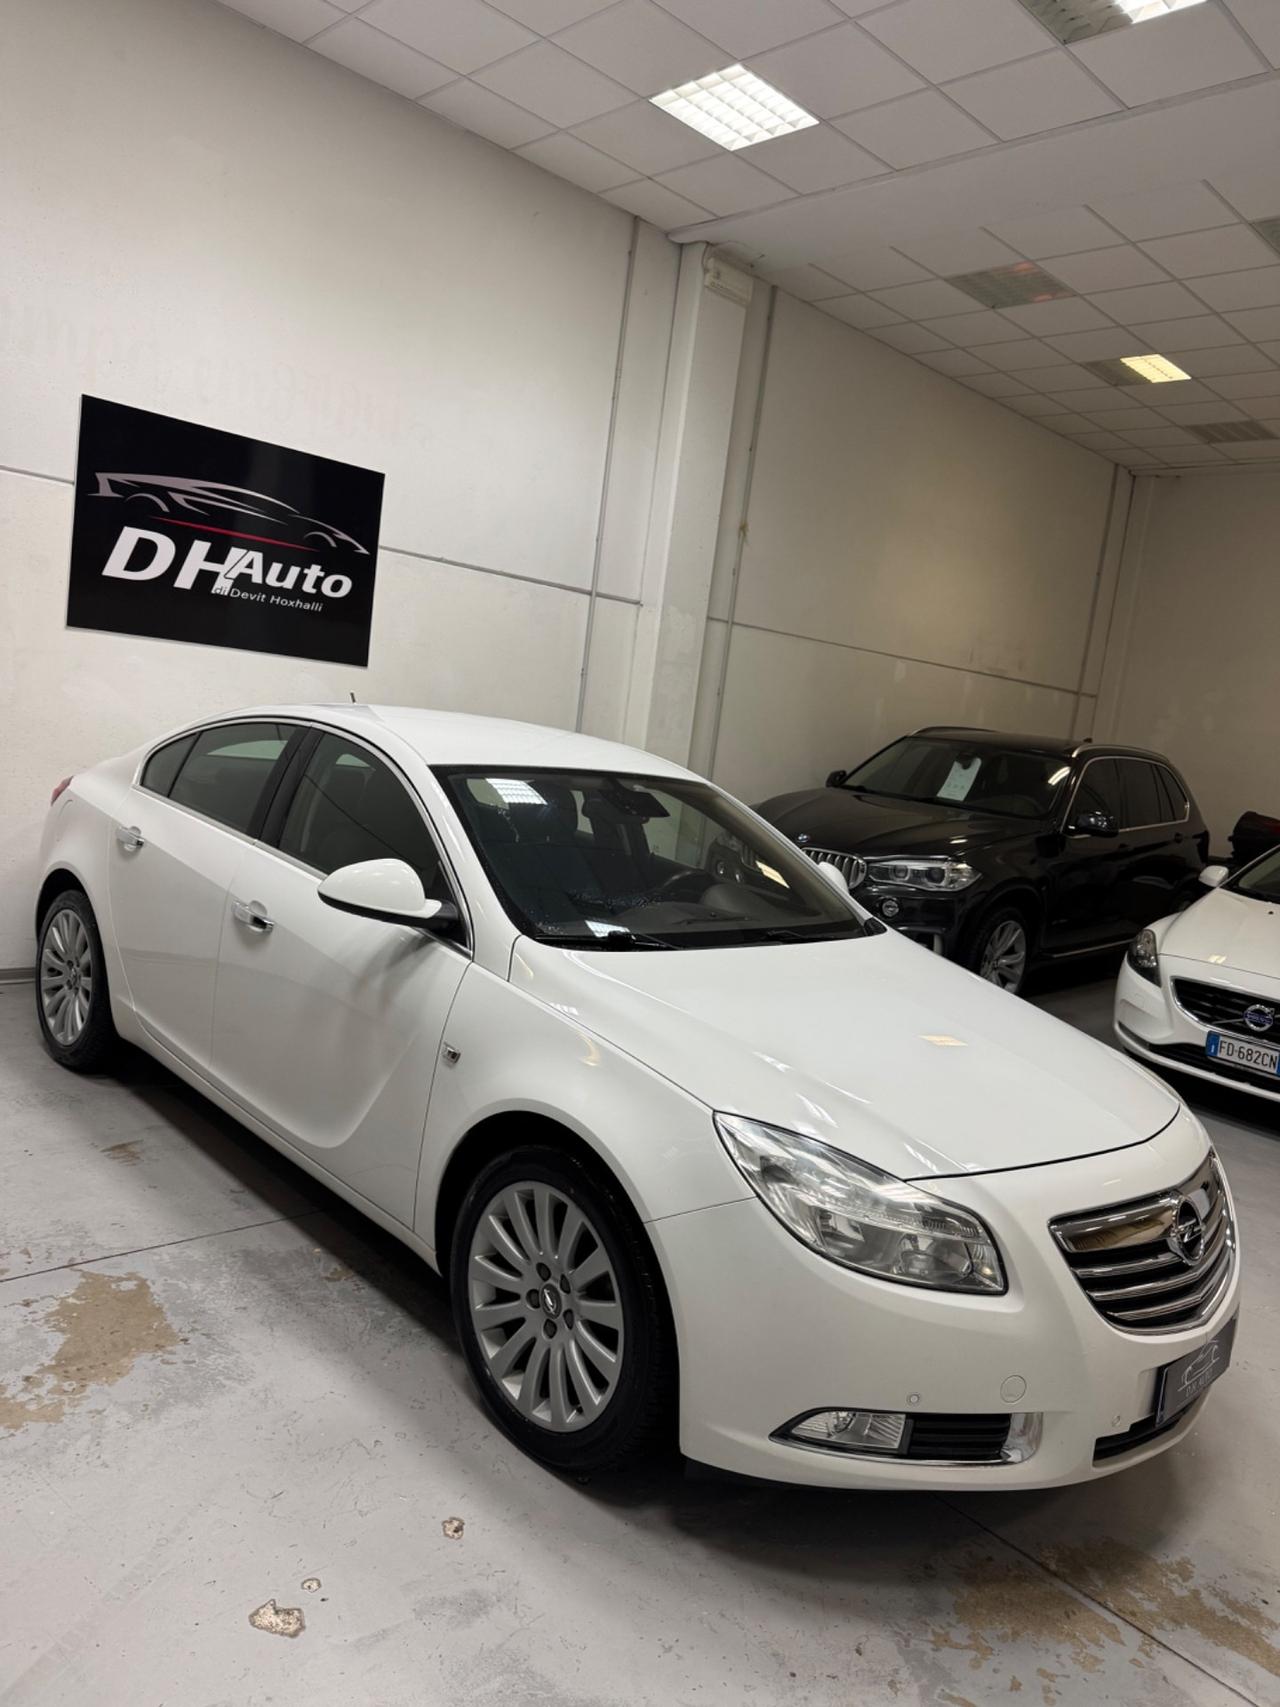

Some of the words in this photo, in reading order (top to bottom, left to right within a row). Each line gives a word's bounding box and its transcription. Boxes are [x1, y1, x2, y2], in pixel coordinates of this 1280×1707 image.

[223, 550, 353, 598] Auto
[229, 588, 267, 603] Devit
[269, 595, 324, 612] Hoxhalli
